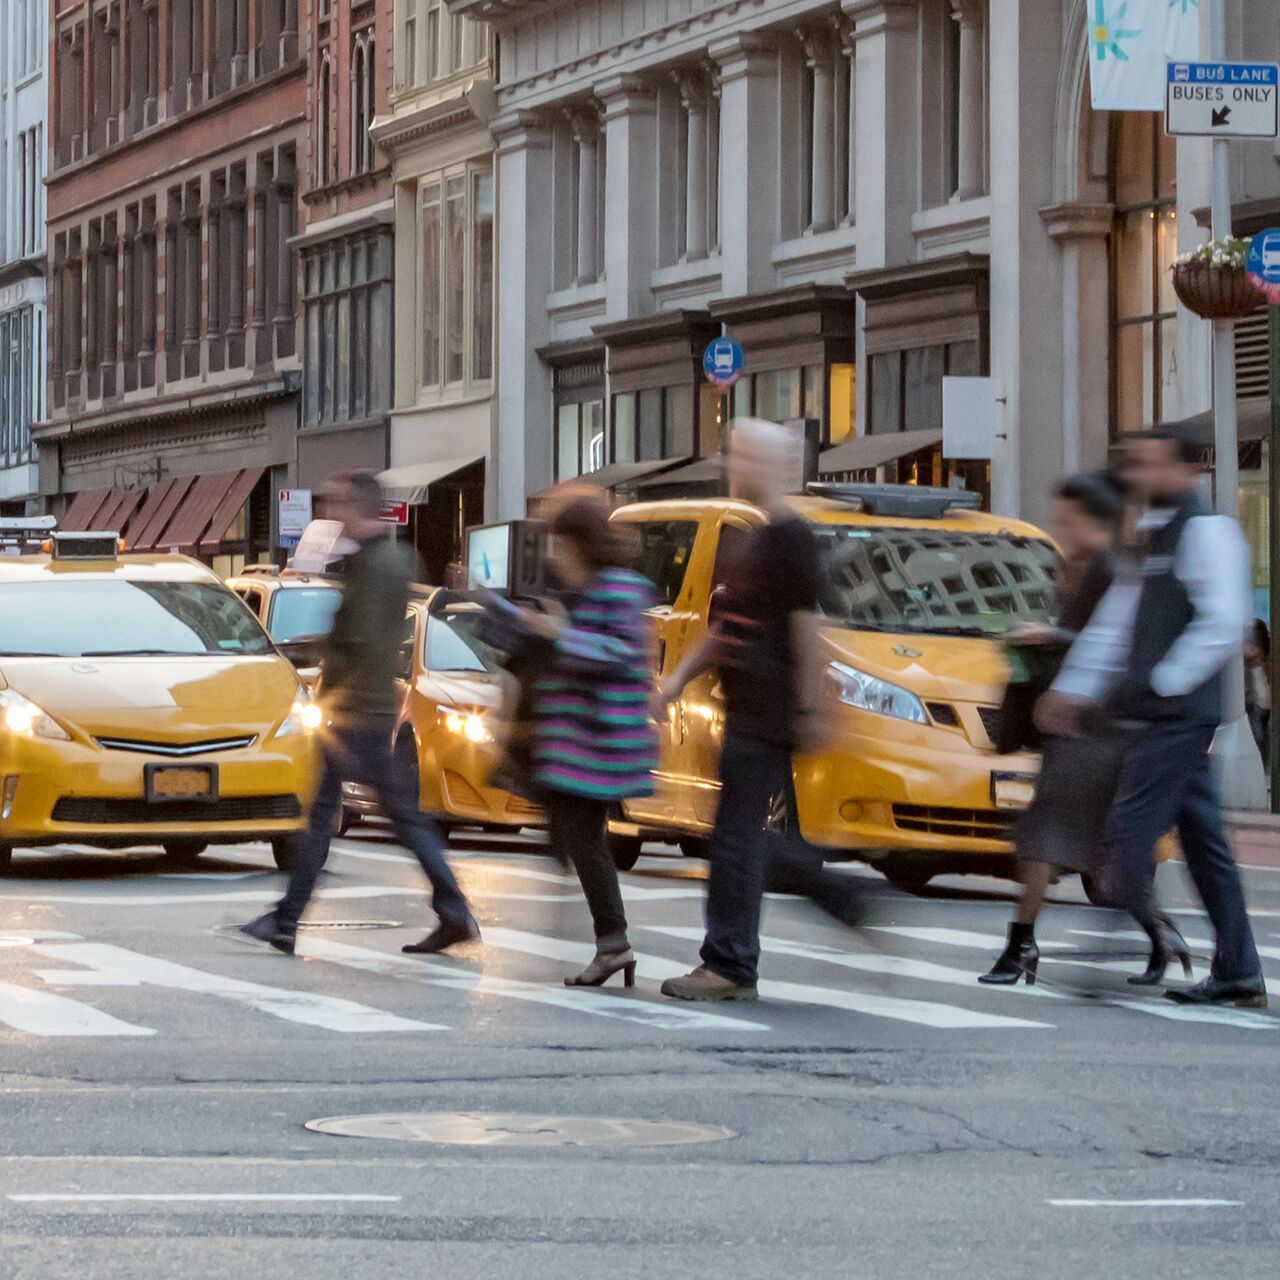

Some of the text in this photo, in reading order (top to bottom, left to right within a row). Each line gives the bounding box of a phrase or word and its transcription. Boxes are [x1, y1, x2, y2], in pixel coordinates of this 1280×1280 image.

[1196, 66, 1271, 81] BUS LANE
[1173, 85, 1271, 102] BUSES ONLY
